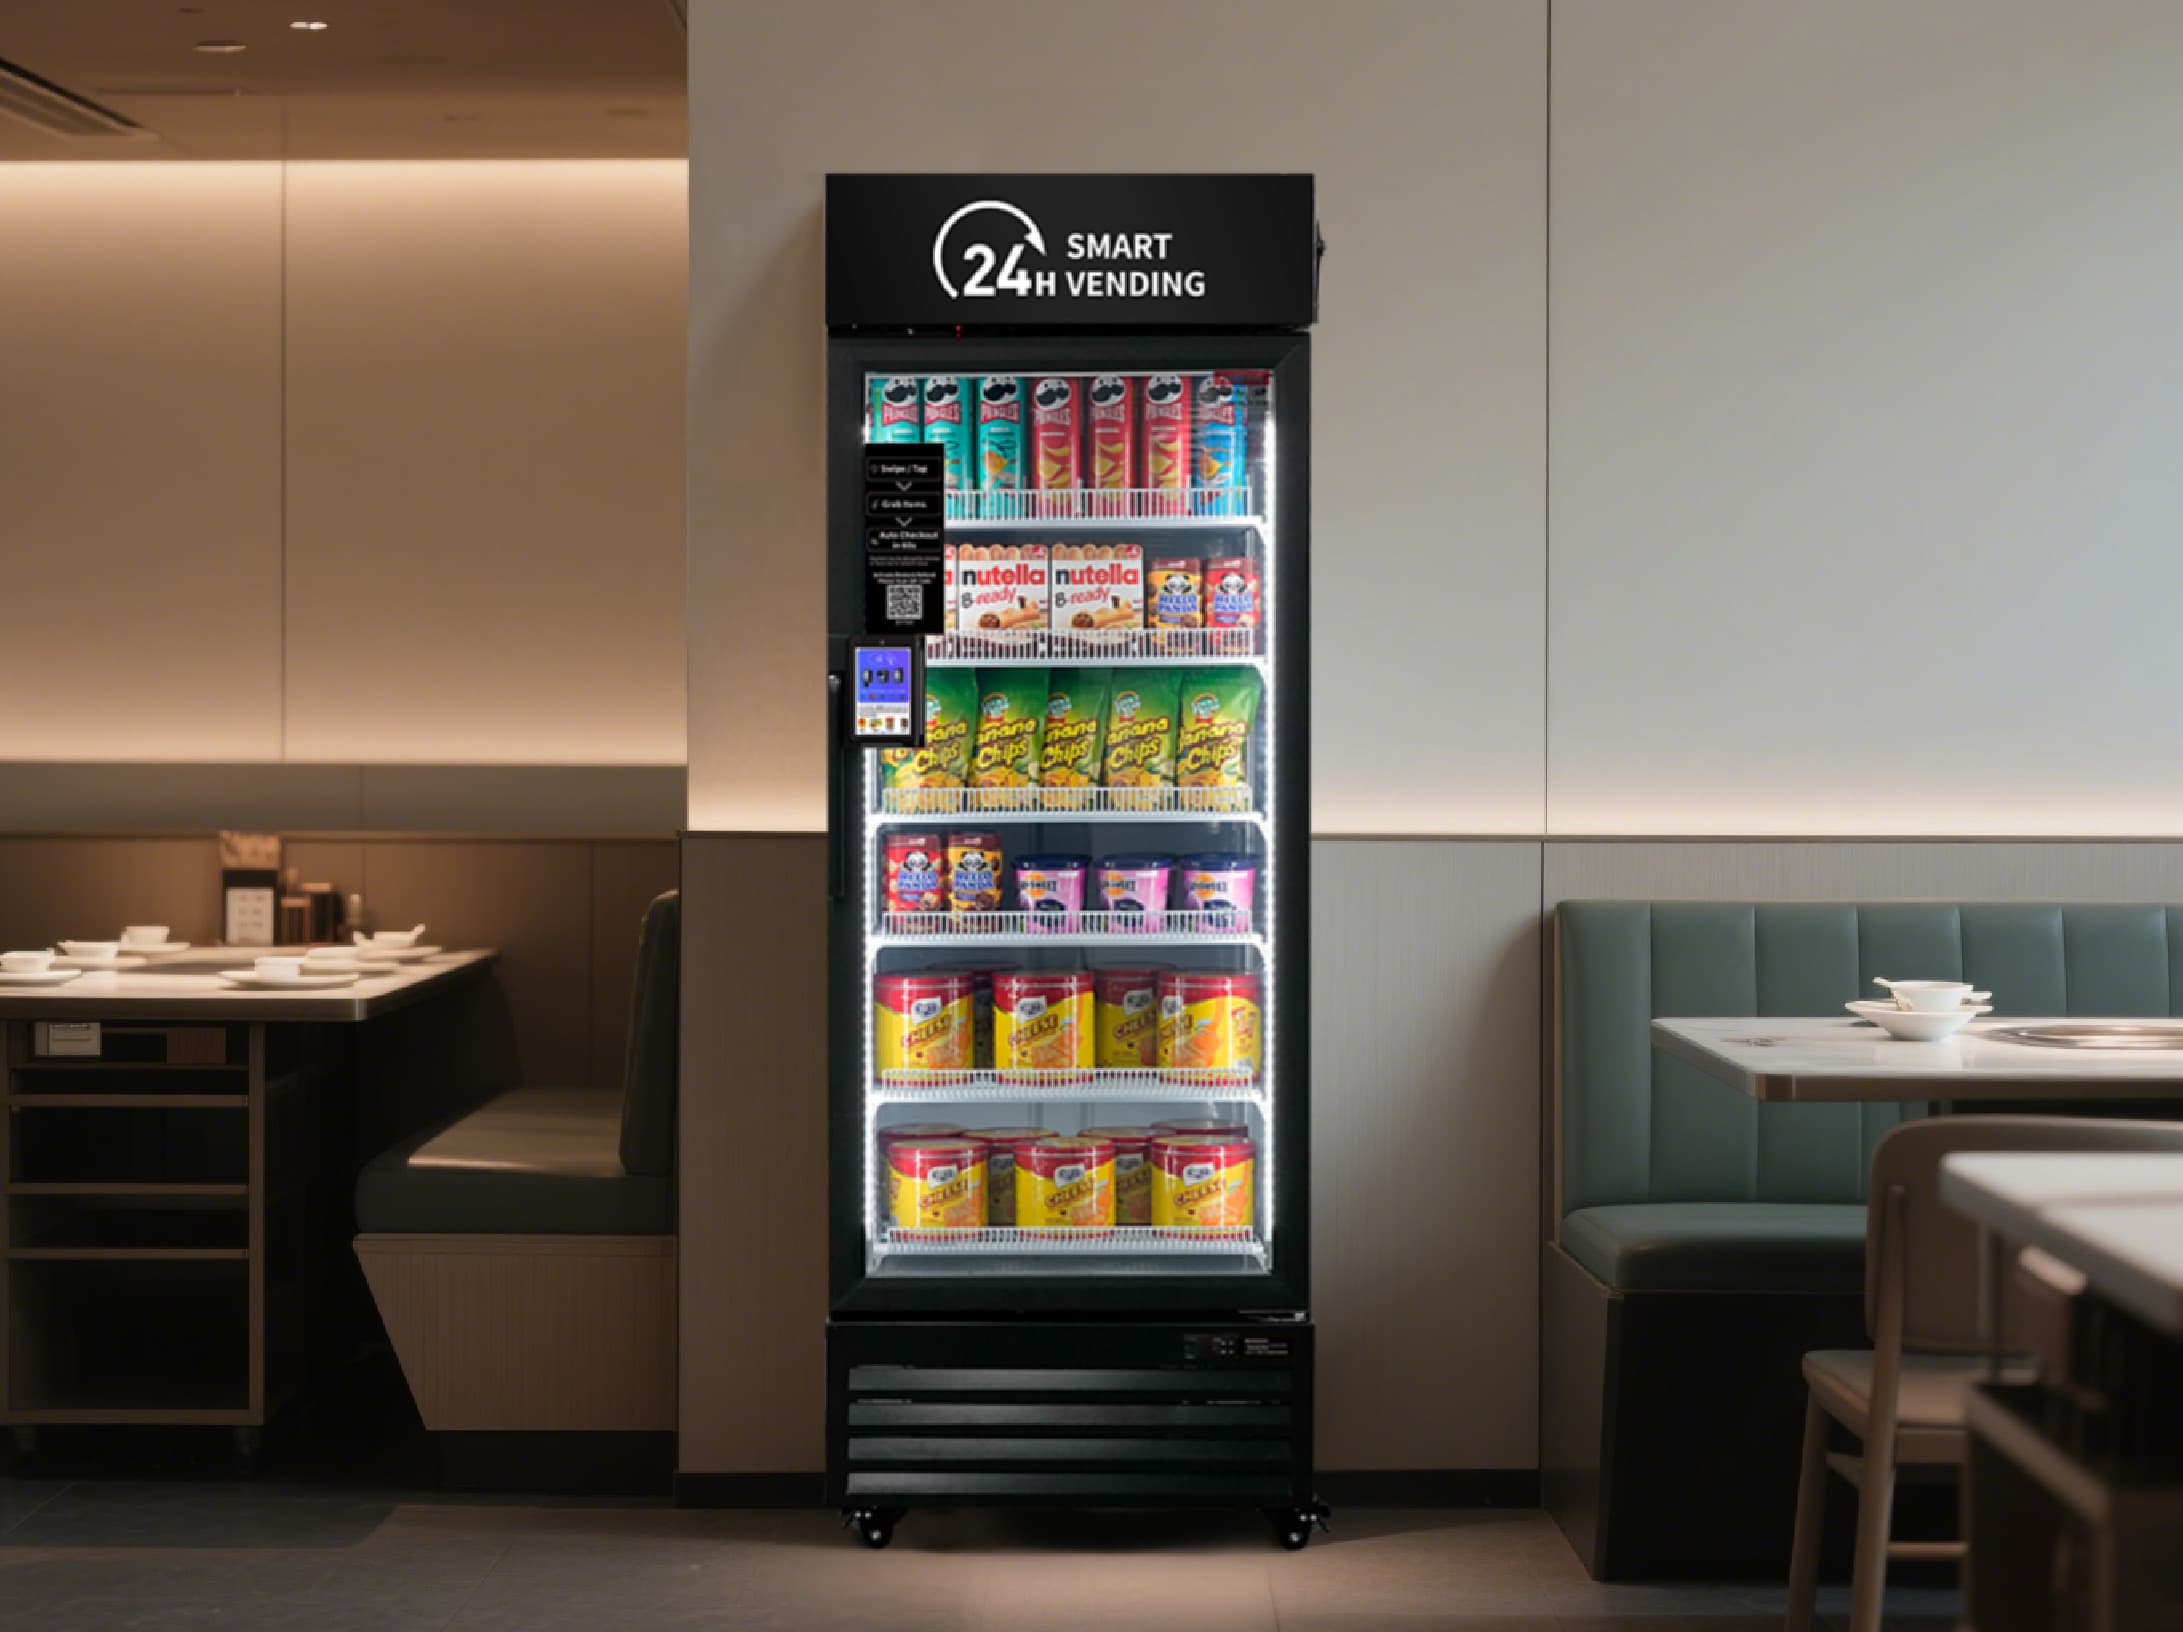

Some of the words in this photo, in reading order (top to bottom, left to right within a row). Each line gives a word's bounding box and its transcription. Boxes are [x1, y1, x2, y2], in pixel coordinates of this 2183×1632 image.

[1066, 232, 1173, 259] SMART
[1065, 271, 1206, 298] VENDING
[962, 563, 1046, 585] nutella
[1055, 563, 1139, 585] nutella
[977, 738, 1028, 769] Chips
[1111, 737, 1161, 769] Chips
[1187, 740, 1237, 770] Chips
